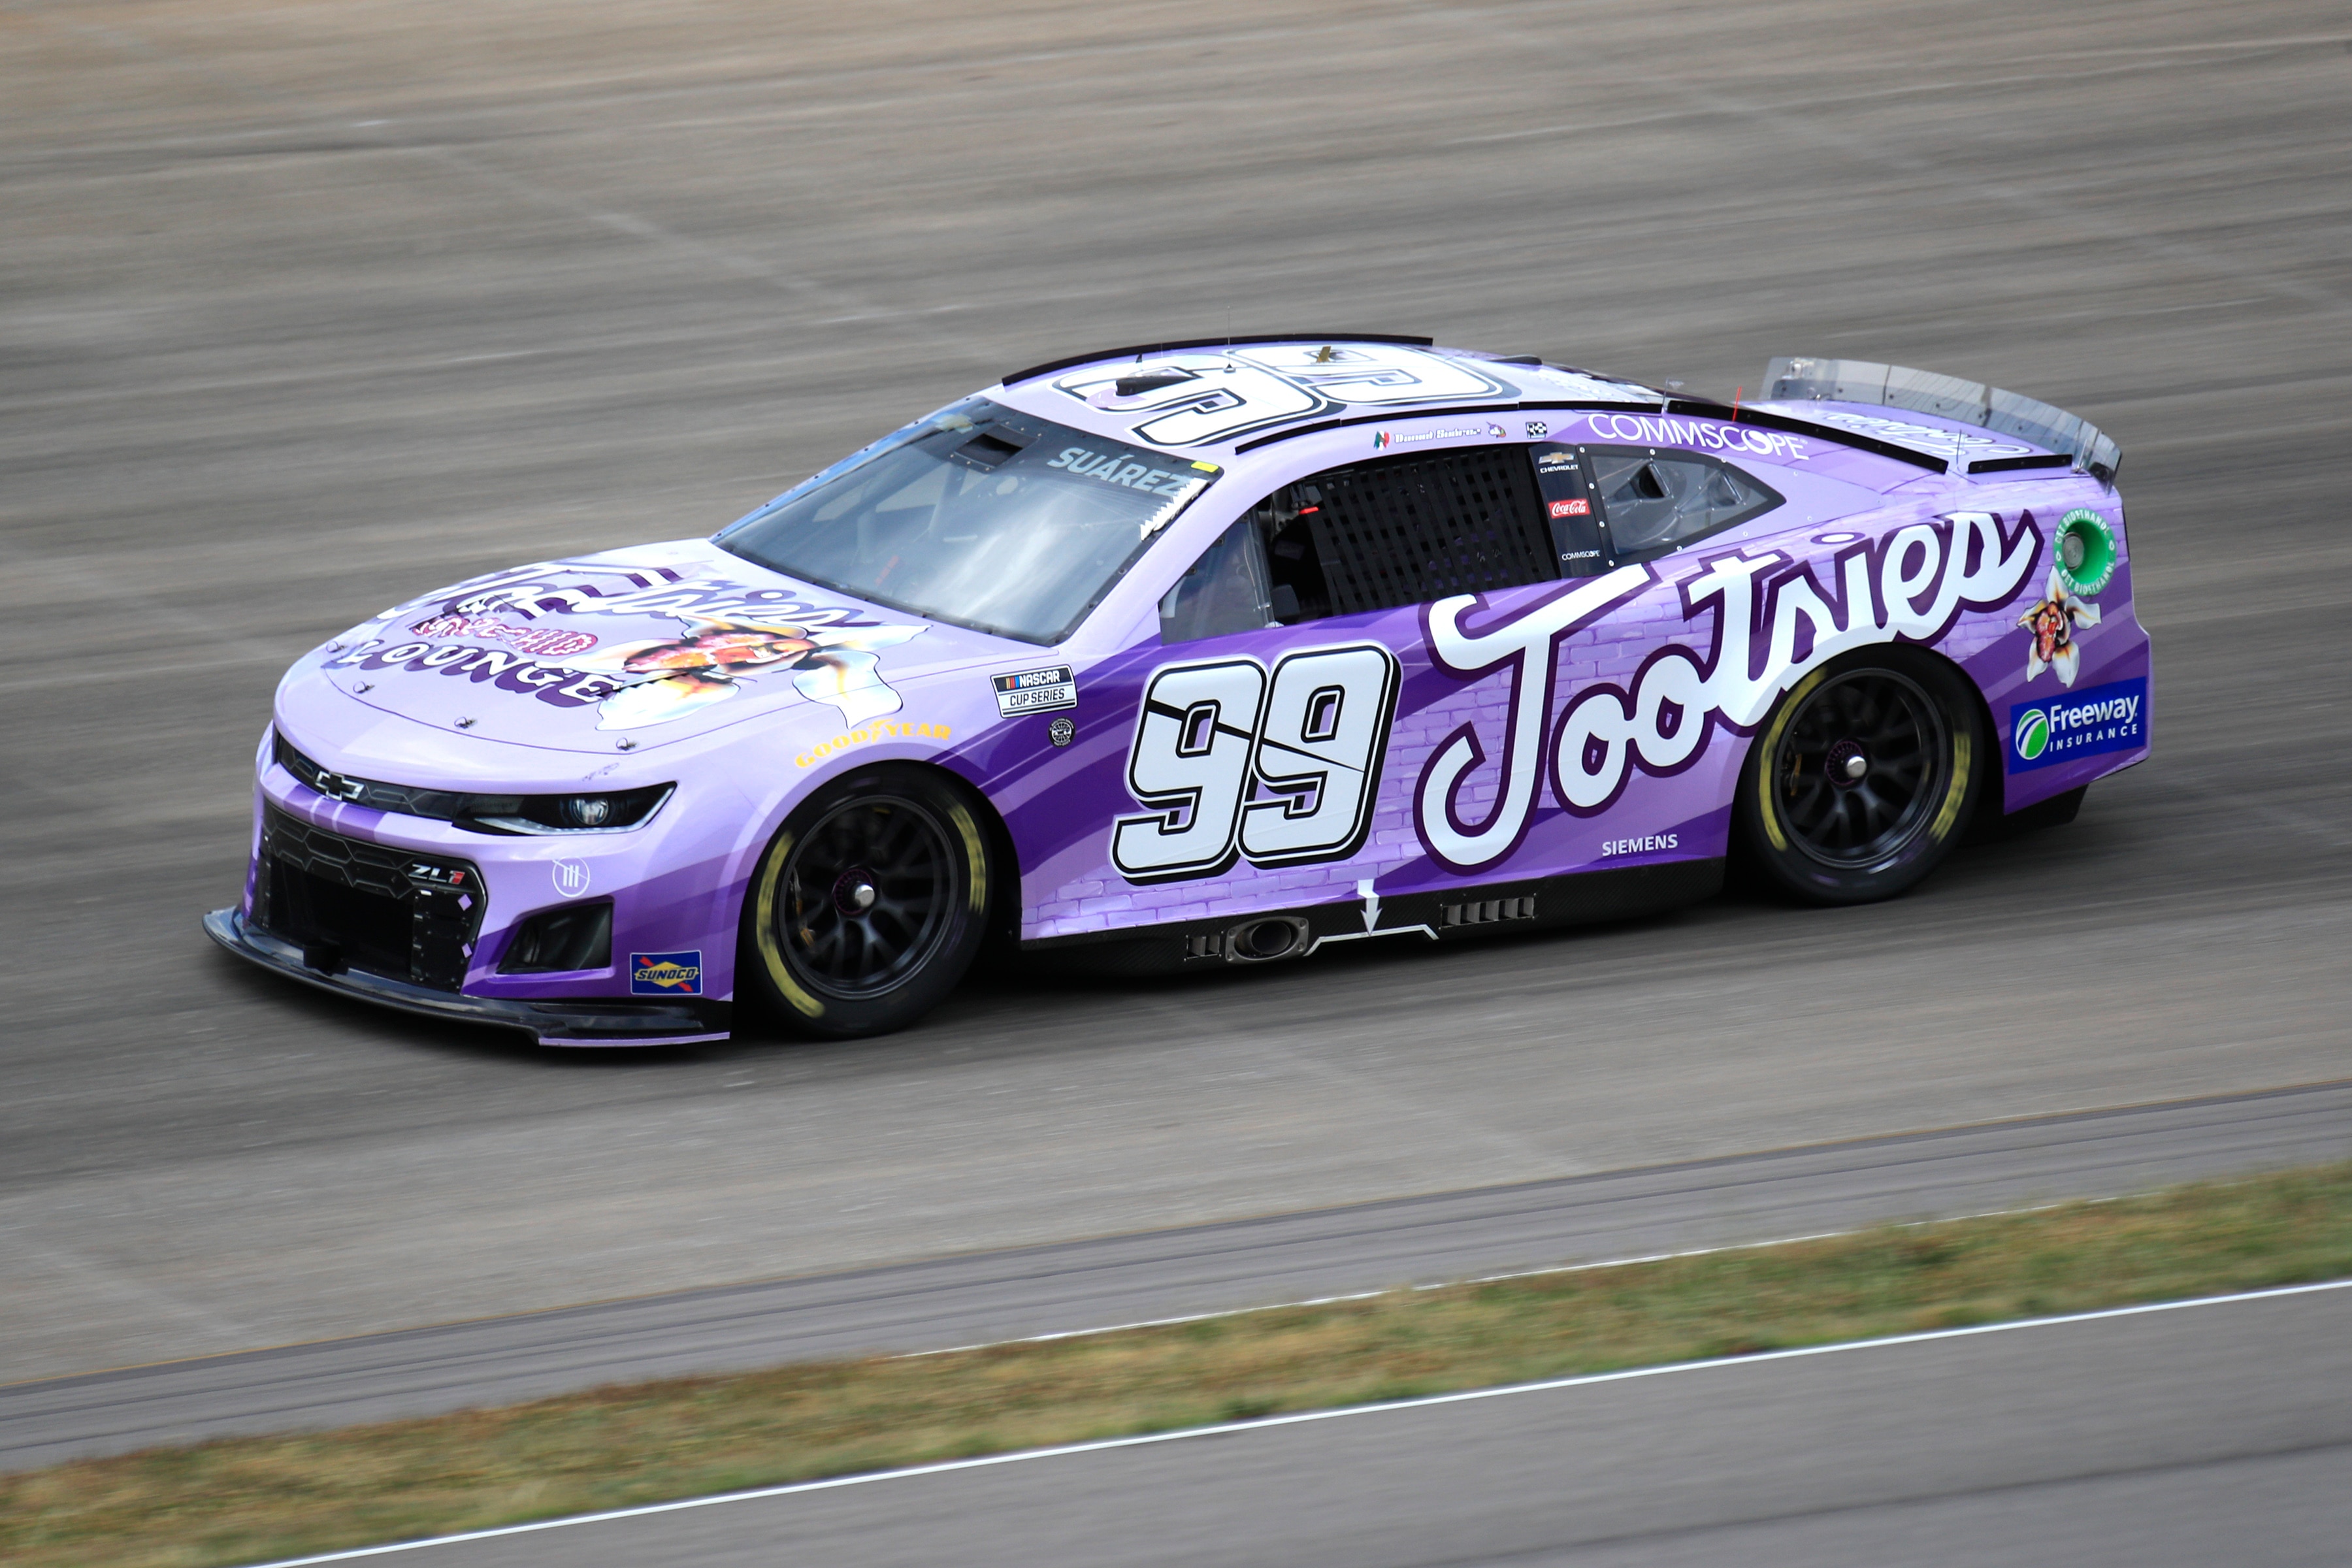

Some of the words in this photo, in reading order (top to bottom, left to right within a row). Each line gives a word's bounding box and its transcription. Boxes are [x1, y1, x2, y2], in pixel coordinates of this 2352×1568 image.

[1588, 414, 1809, 460] COMMSCOPE
[1047, 447, 1193, 496] SUÁREZ
[1540, 464, 1578, 474] CHEVROLET
[2055, 525, 2066, 544] GET
[1561, 549, 1601, 561] COMMSCOPE
[323, 640, 625, 707] LOUNGE
[1019, 670, 1060, 688] NASCAR
[1010, 693, 1029, 706] CUP
[1031, 688, 1065, 704] SERIES
[1414, 509, 2044, 874] Tootsies
[2050, 694, 2139, 733] Freeway
[795, 719, 951, 768] GOODYEAR
[2050, 723, 2137, 752] INSURANCE
[1110, 640, 1402, 887] 99
[1602, 834, 1678, 858] SIEMENS
[408, 863, 465, 885] ZL1
[636, 968, 698, 980] SUNOCO
